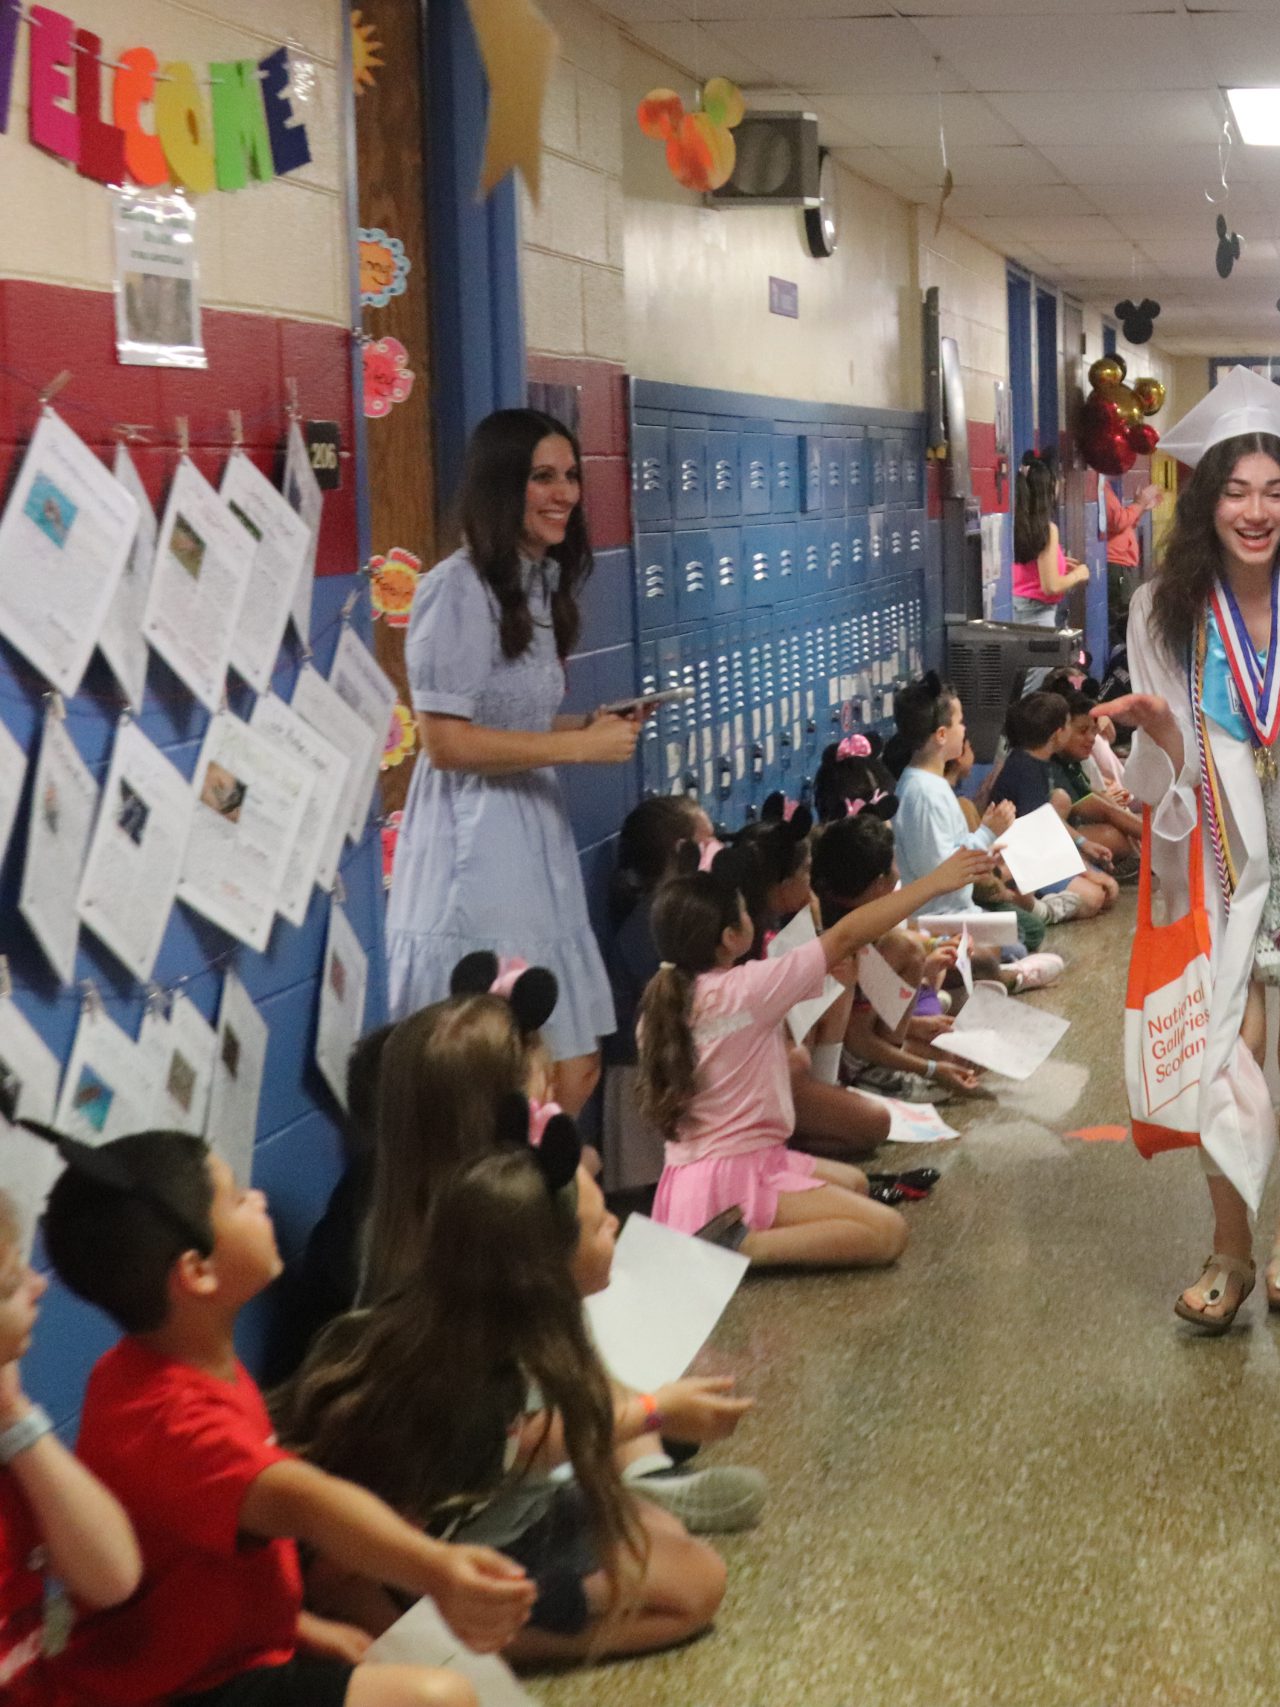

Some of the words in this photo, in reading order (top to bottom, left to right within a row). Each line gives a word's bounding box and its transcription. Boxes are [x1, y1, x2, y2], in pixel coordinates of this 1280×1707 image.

[0, 0, 312, 193] ELCOME
[311, 443, 337, 469] 206
[1147, 980, 1205, 1038] National
[1155, 1037, 1206, 1083] Scoan
